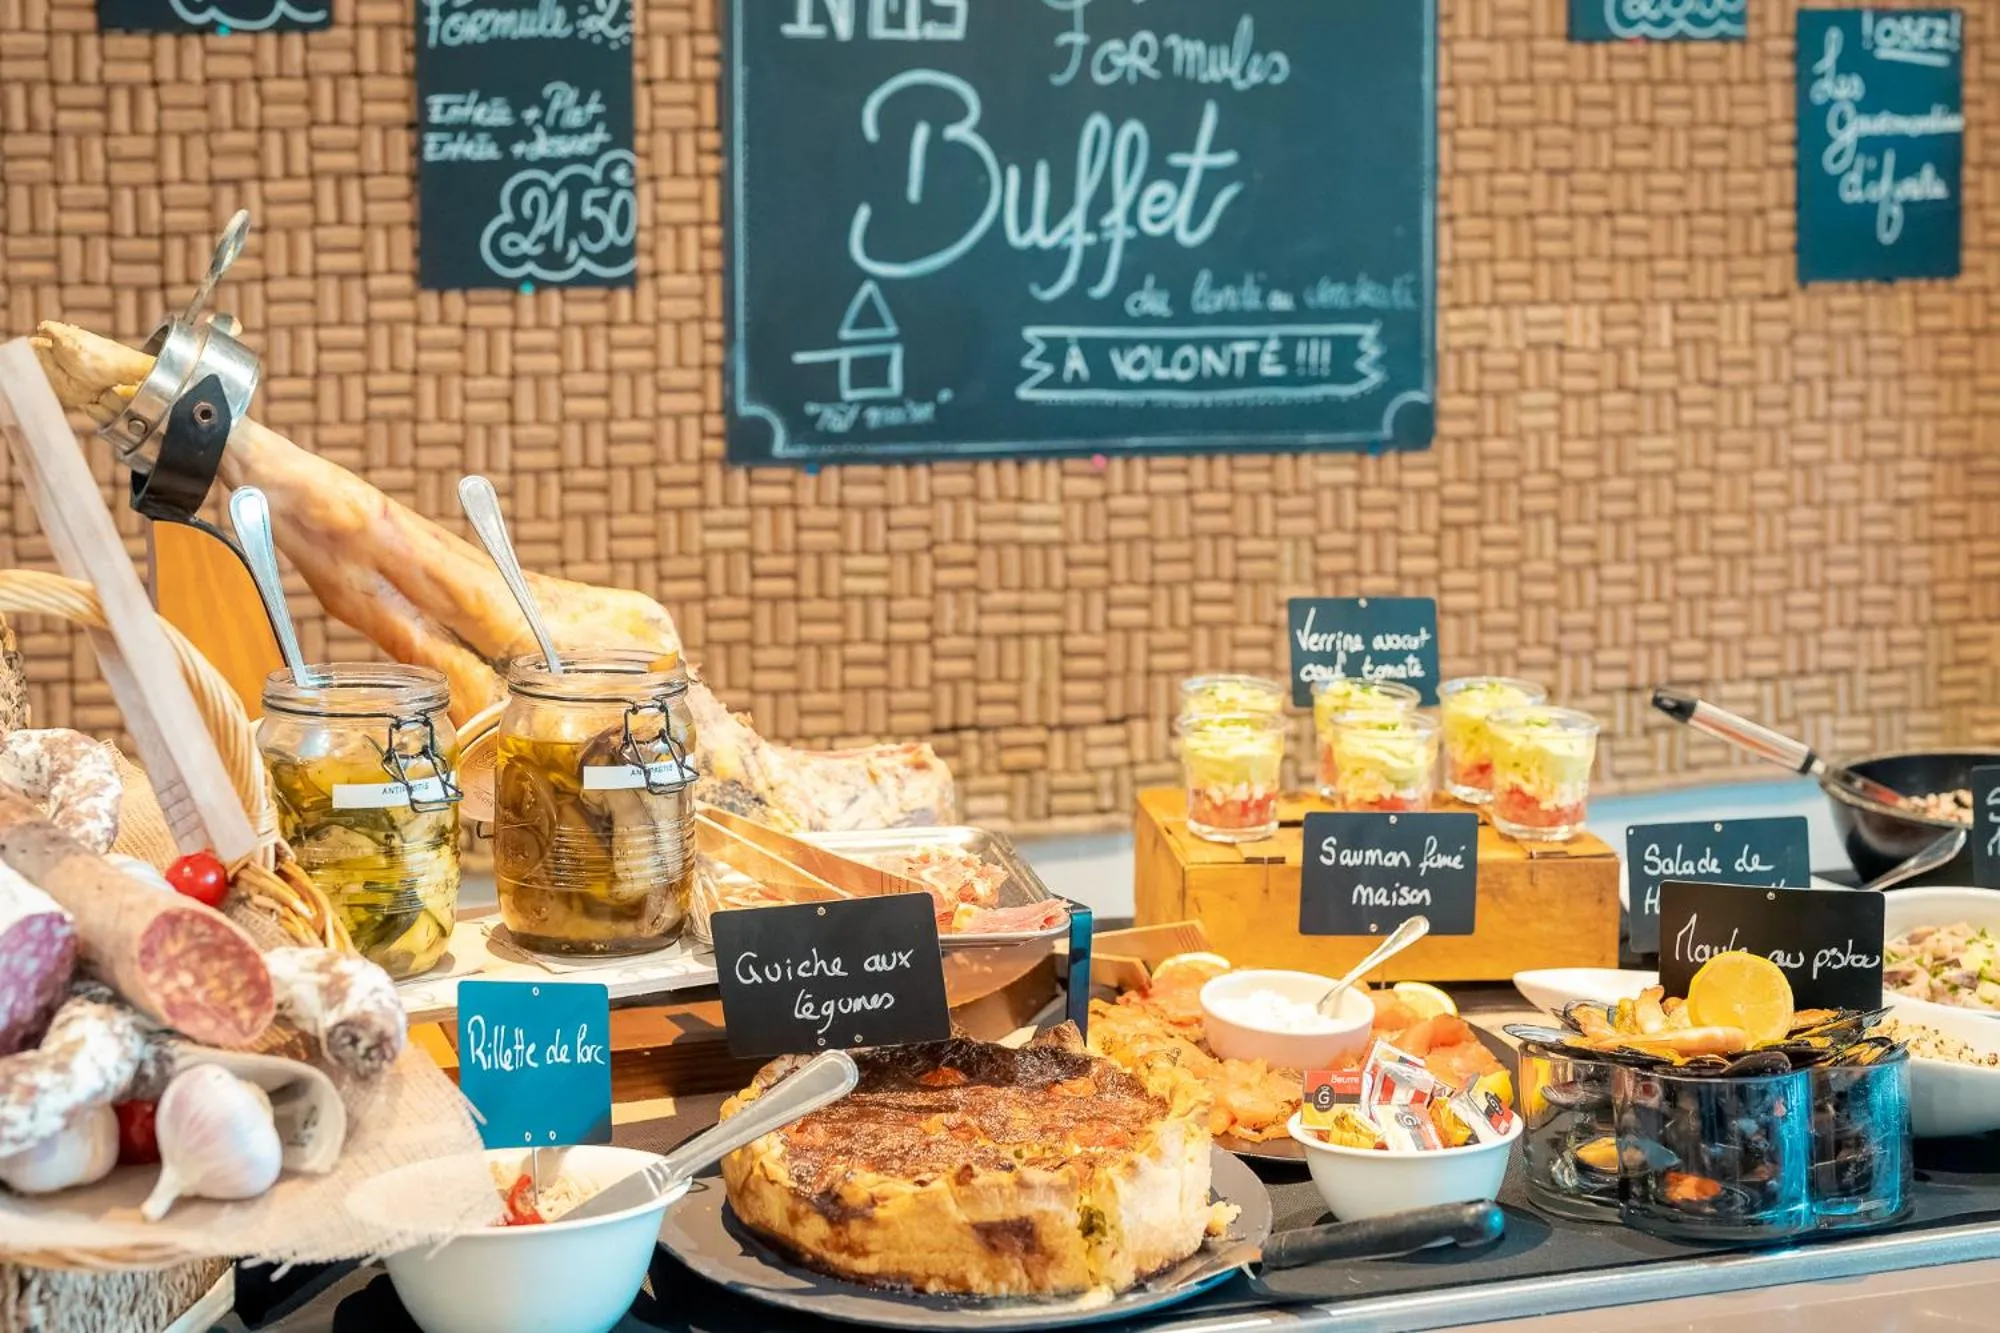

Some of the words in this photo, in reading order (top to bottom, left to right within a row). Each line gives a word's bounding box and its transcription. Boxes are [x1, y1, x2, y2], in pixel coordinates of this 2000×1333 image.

[849, 68, 1243, 301] Buffet
[1109, 332, 1288, 382] VOLONTÉ
[1296, 606, 1365, 653] Verrine
[1319, 836, 1411, 868] Saumon
[1643, 844, 1722, 876] Salade
[1734, 844, 1775, 873] de
[1352, 883, 1432, 907] maison
[863, 948, 914, 973] aux
[1768, 949, 1805, 969] au
[1812, 939, 1881, 980] pistou
[794, 988, 896, 1034] légumes
[467, 1015, 539, 1071] Rillette
[546, 1028, 572, 1064] de
